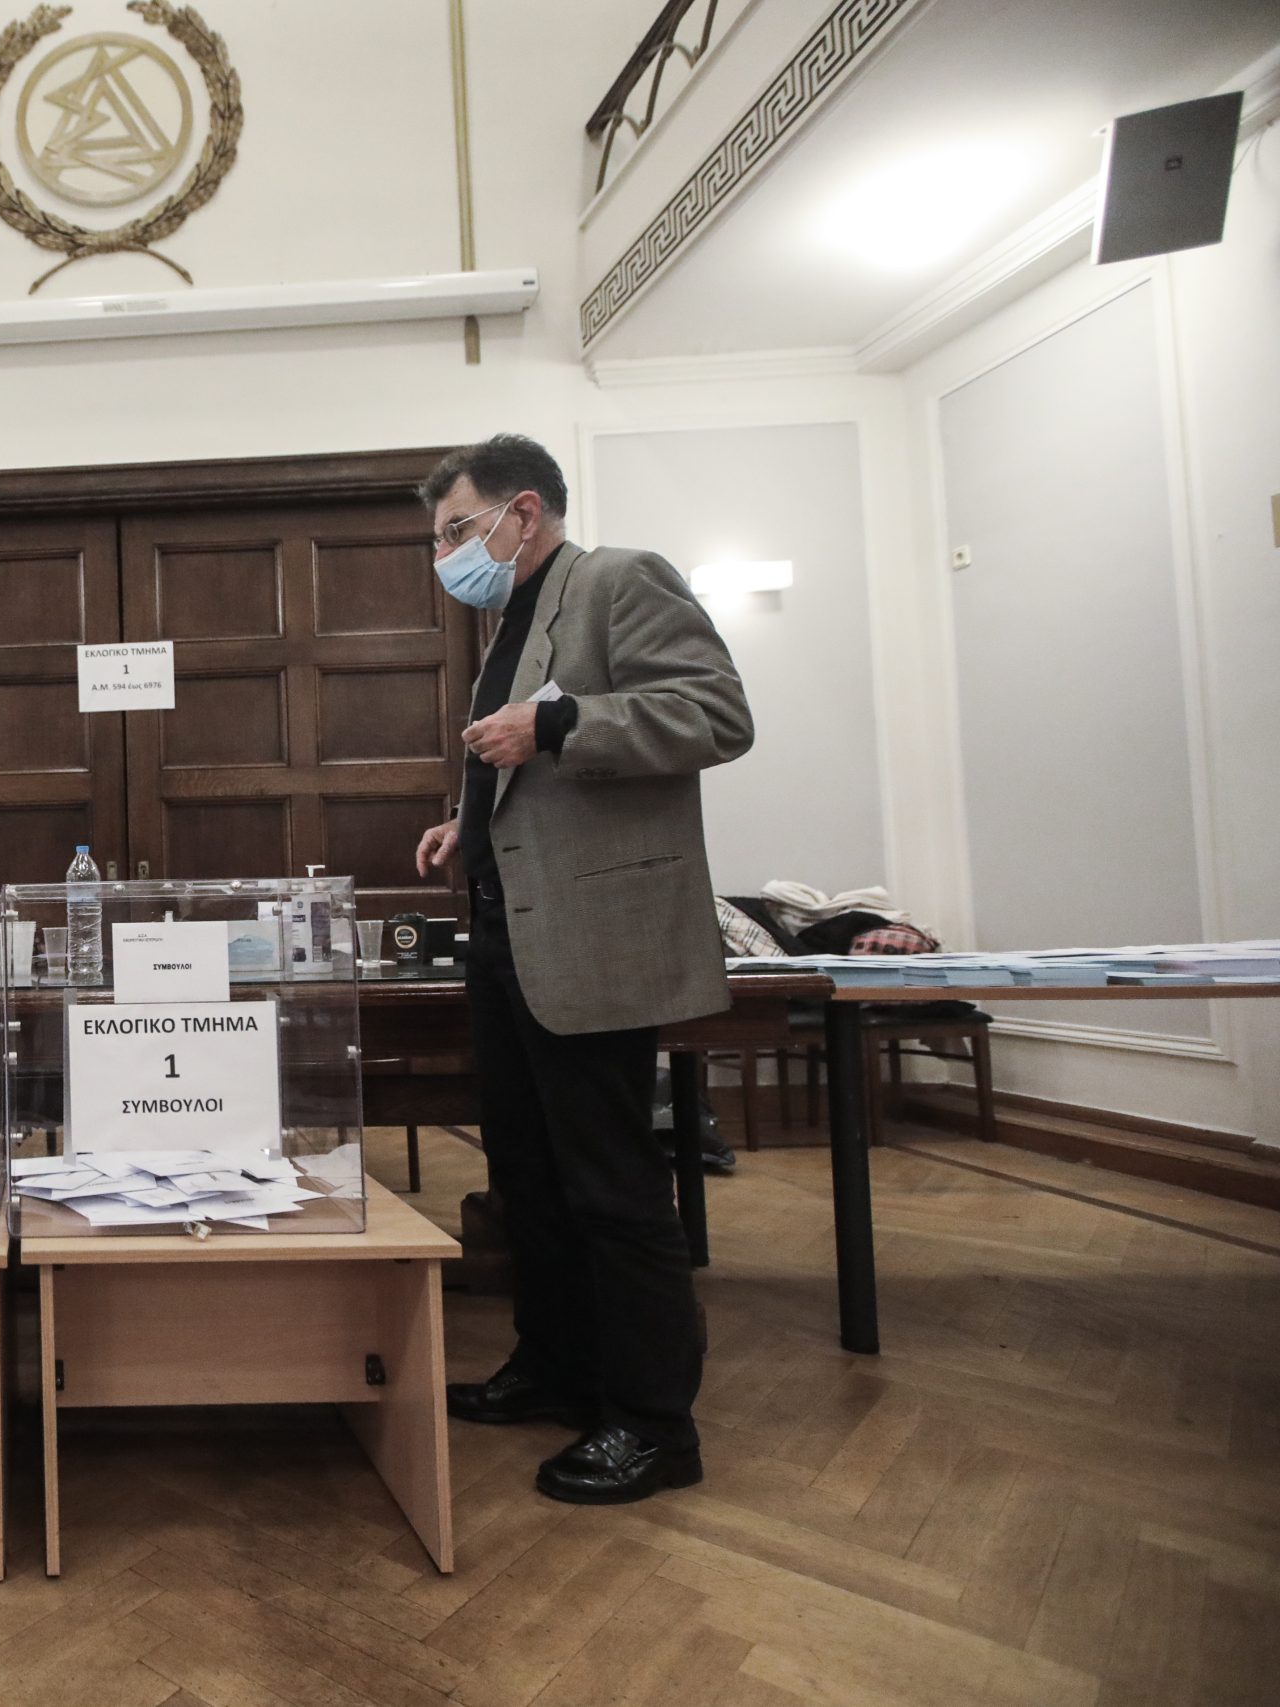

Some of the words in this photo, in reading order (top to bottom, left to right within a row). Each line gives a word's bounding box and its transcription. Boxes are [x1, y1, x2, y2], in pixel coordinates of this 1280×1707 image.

[85, 649, 128, 657] ΕΚΛΟΓΙΚΟ
[131, 647, 167, 655] ΤΜΗΜΑ
[123, 664, 129, 675] 1
[83, 1018, 176, 1035] ΕΚΛΟΓΙΚΟ
[180, 1016, 259, 1033] ΤΜΗΜΑ
[164, 1054, 180, 1078] 1
[122, 1098, 223, 1114] ΣΥΜΒΟΥΛΟΙ
